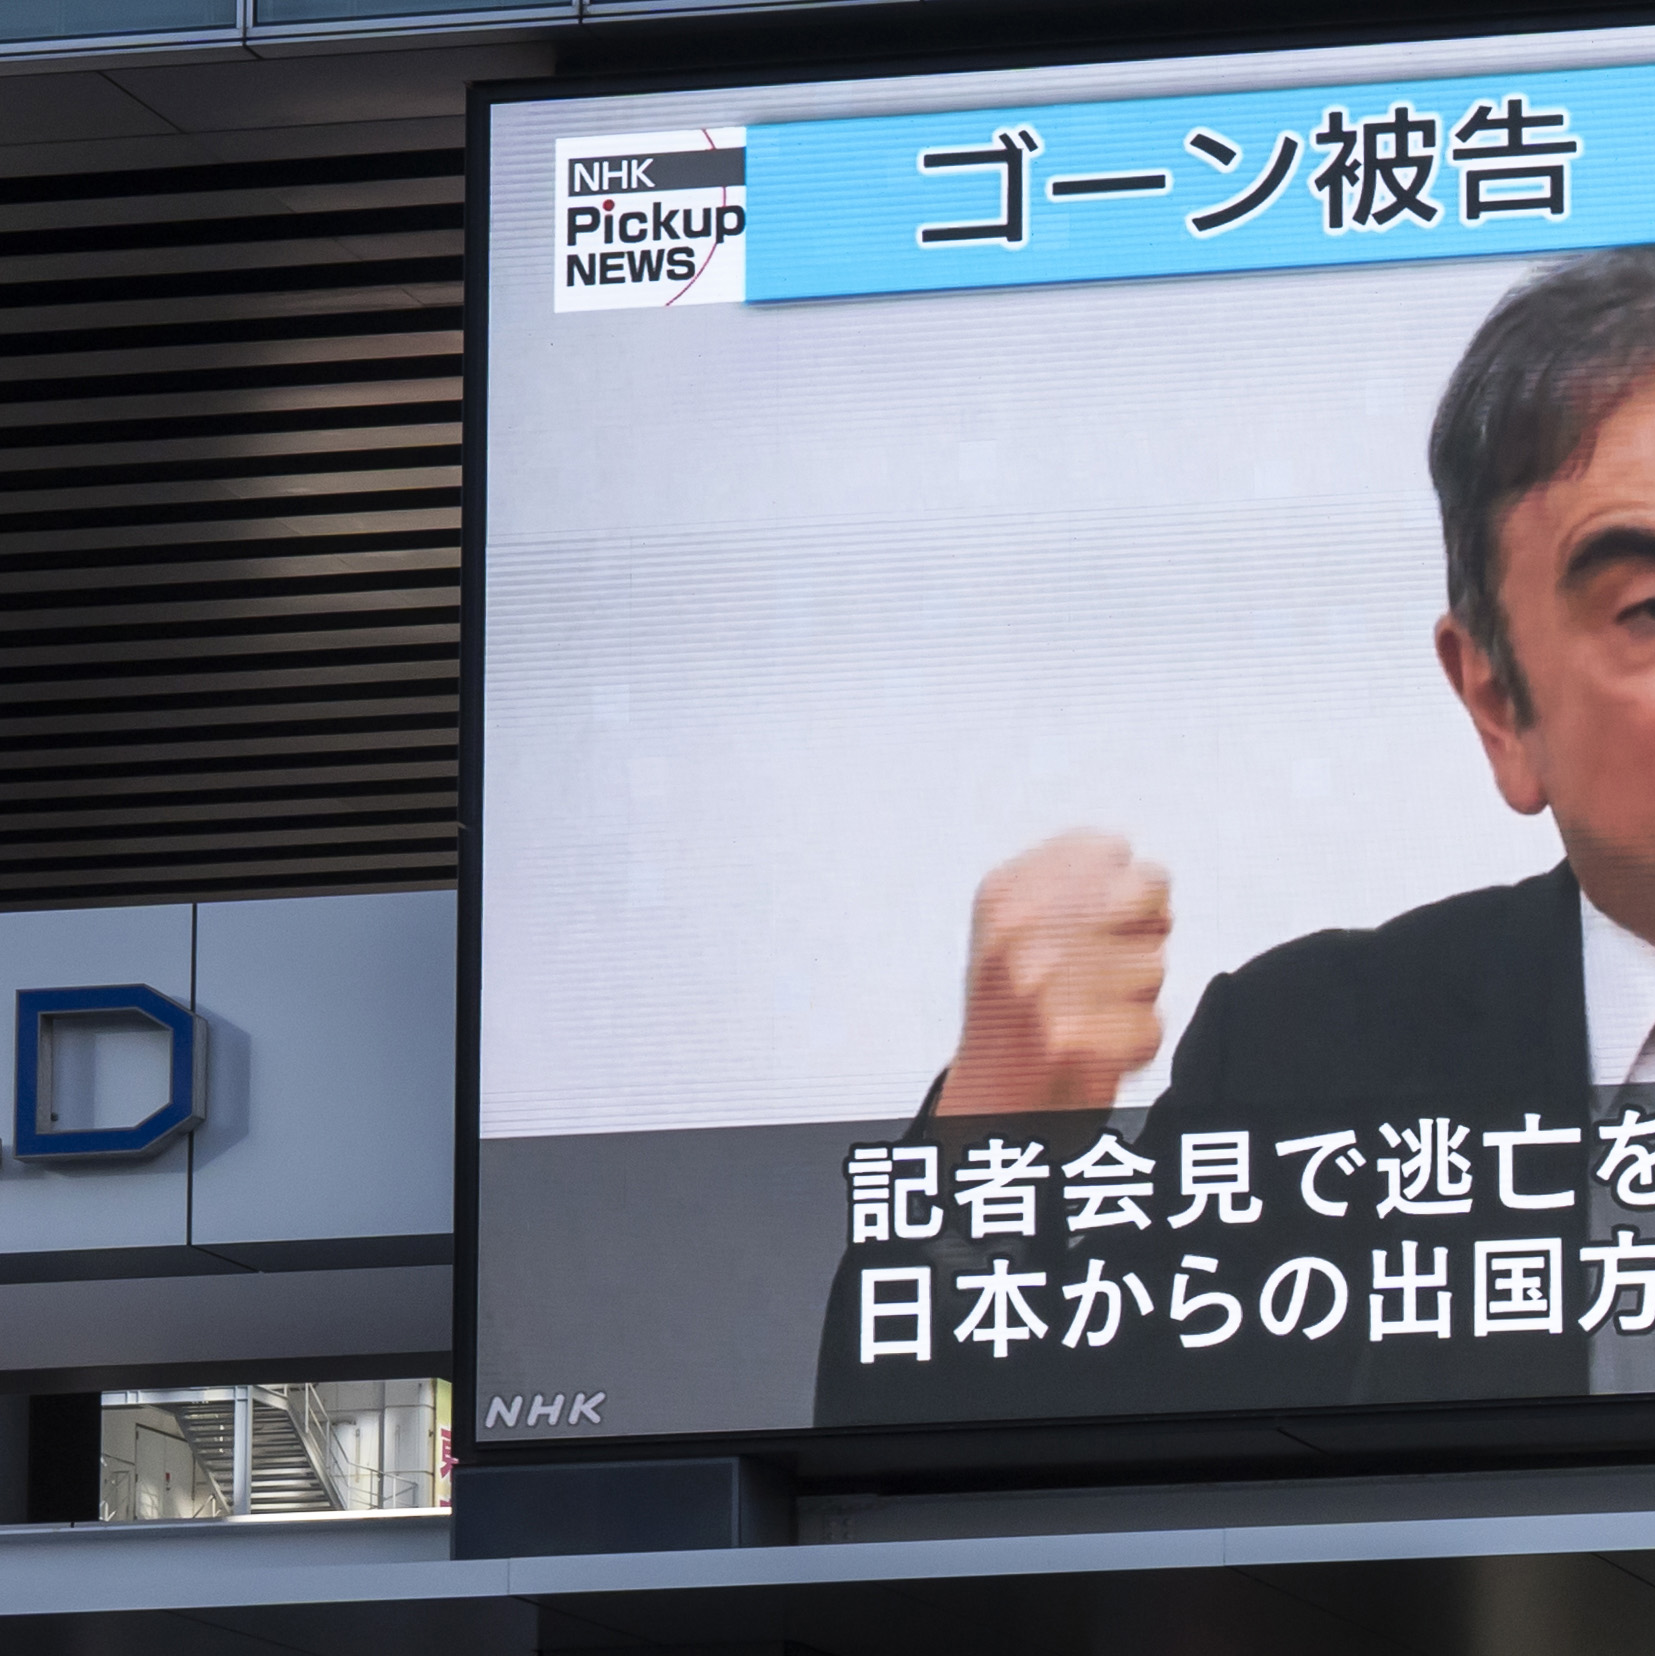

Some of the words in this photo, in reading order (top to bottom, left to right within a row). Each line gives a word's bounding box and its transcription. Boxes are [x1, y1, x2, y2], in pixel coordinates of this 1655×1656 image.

[573, 158, 655, 193] NHK
[918, 98, 1579, 246] ゴーン被告
[567, 199, 746, 246] Pickup
[567, 246, 695, 287] NEWS
[485, 1392, 606, 1428] NHK
